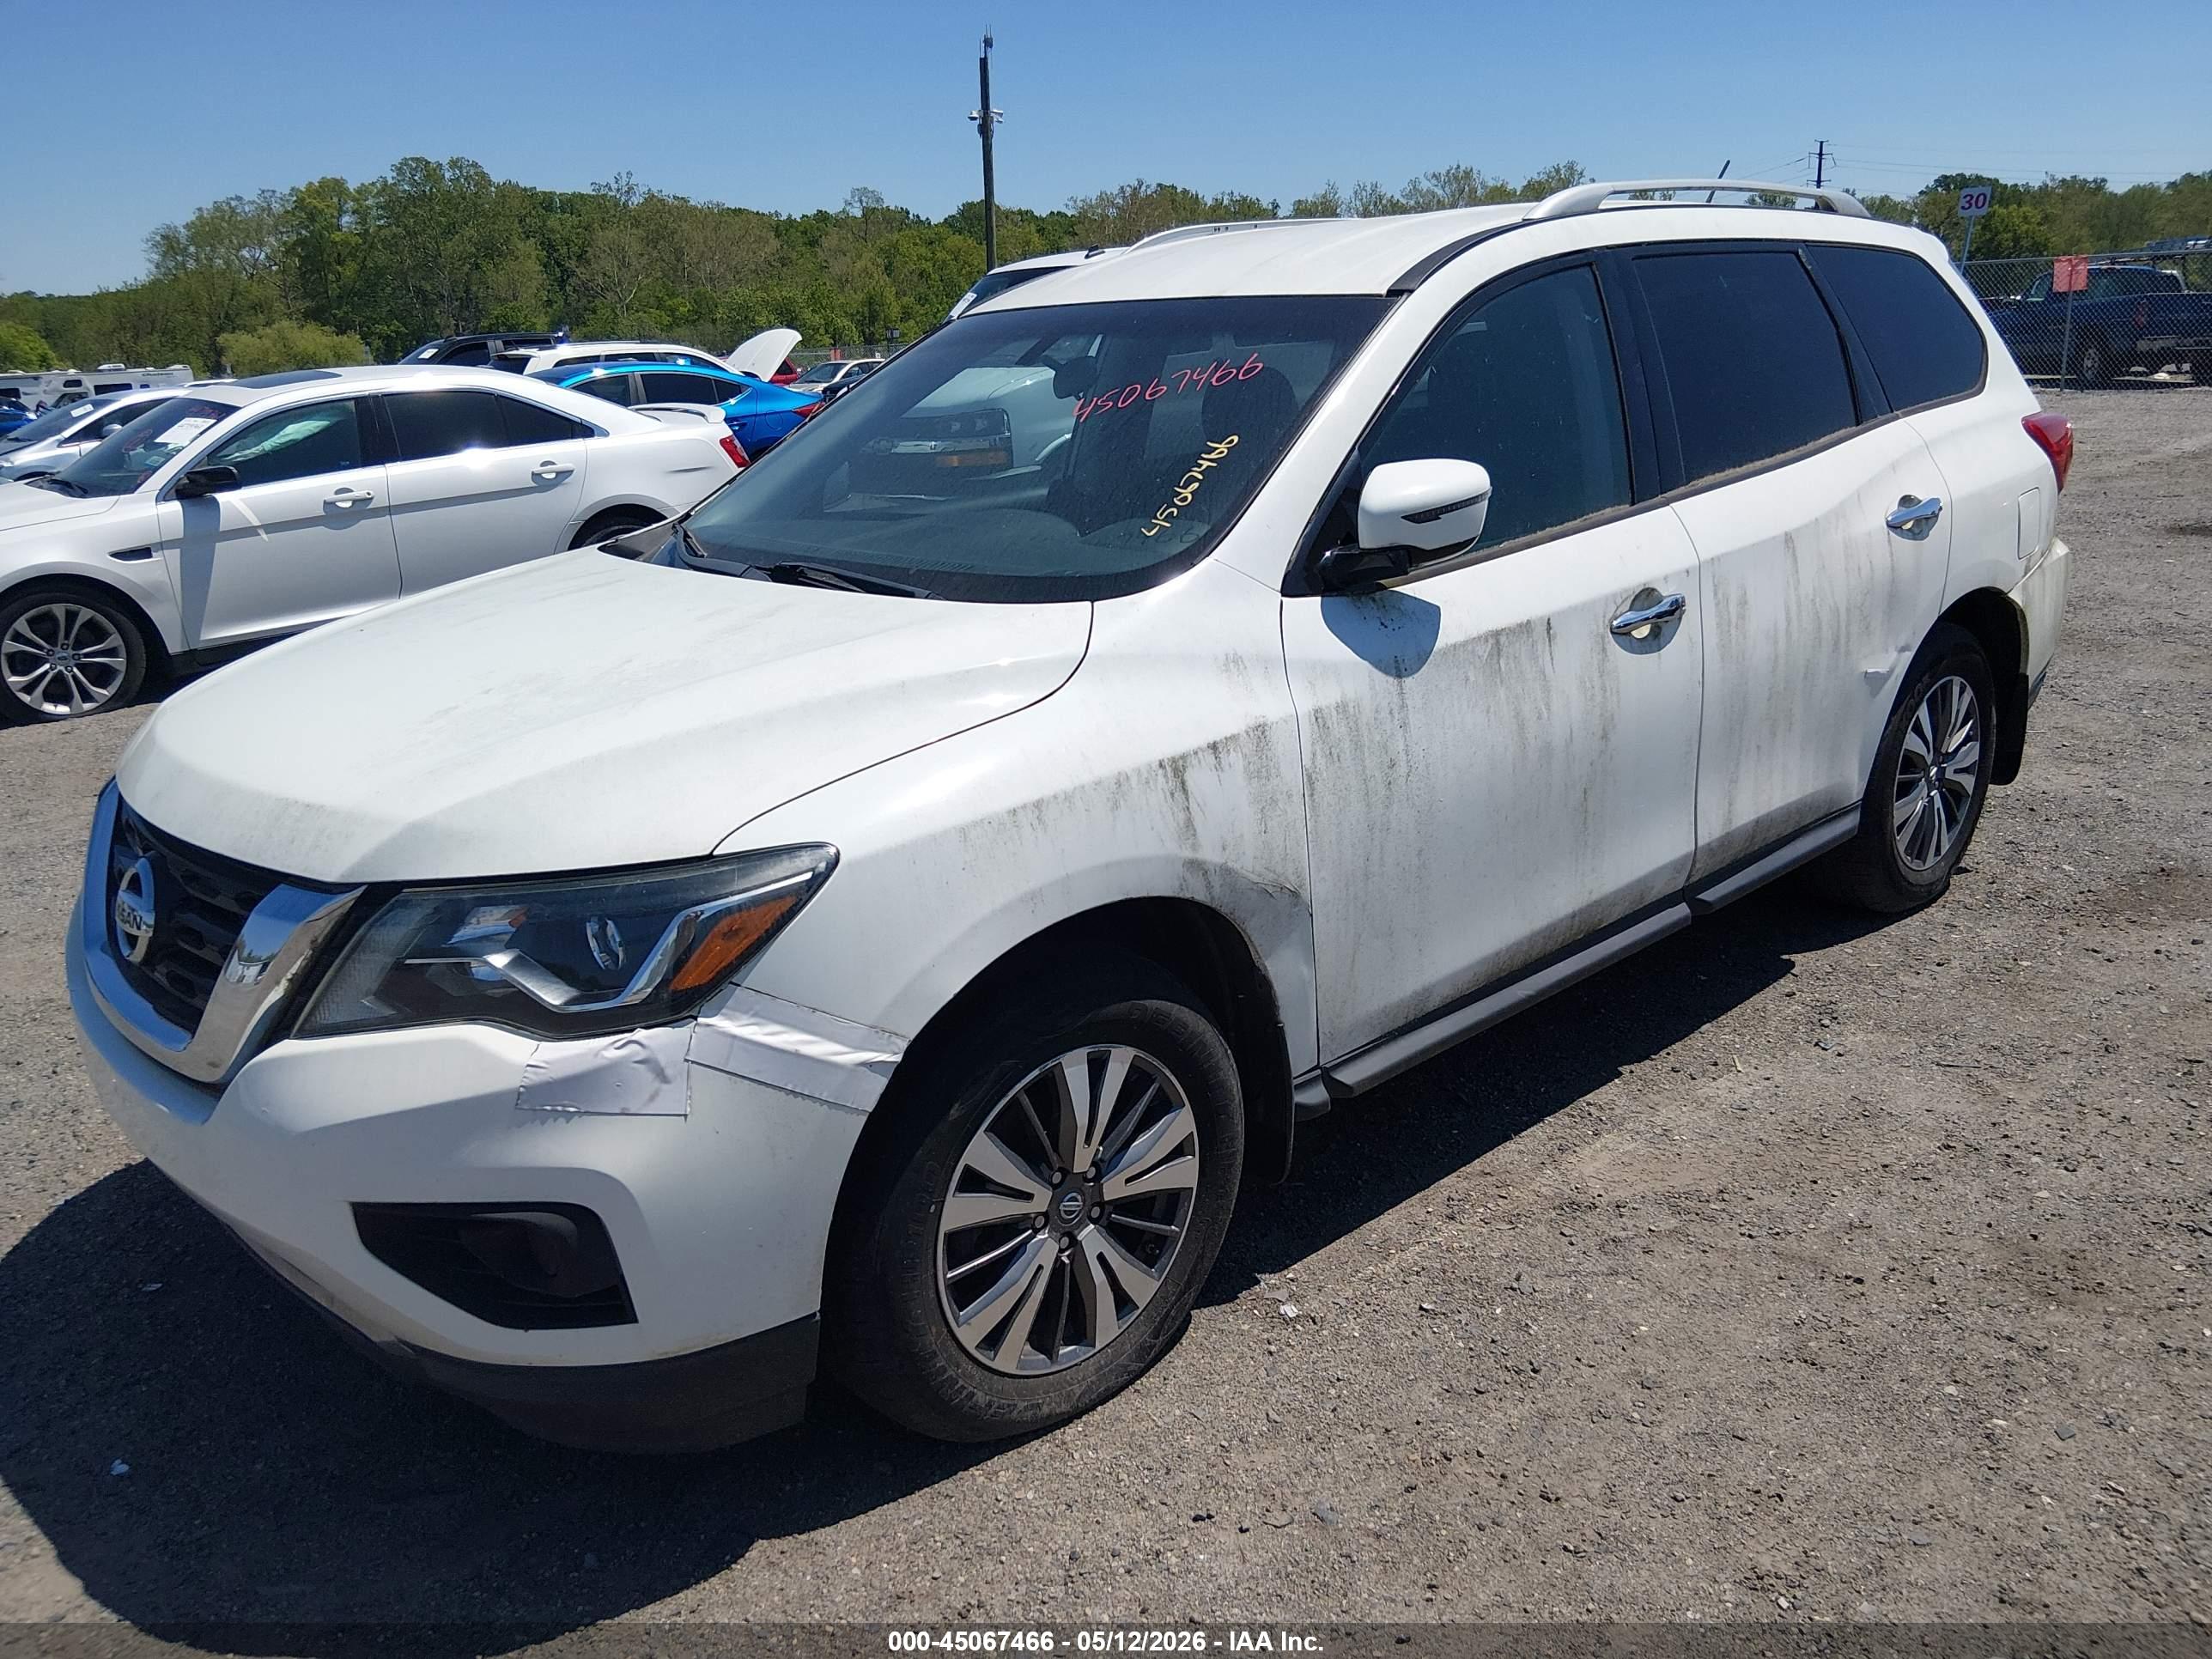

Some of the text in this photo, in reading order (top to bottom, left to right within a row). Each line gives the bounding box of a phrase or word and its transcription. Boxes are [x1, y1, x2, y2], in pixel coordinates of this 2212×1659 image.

[1960, 192, 1987, 210] 30
[1073, 352, 1264, 422] 45067466
[1140, 434, 1239, 537] 45067466
